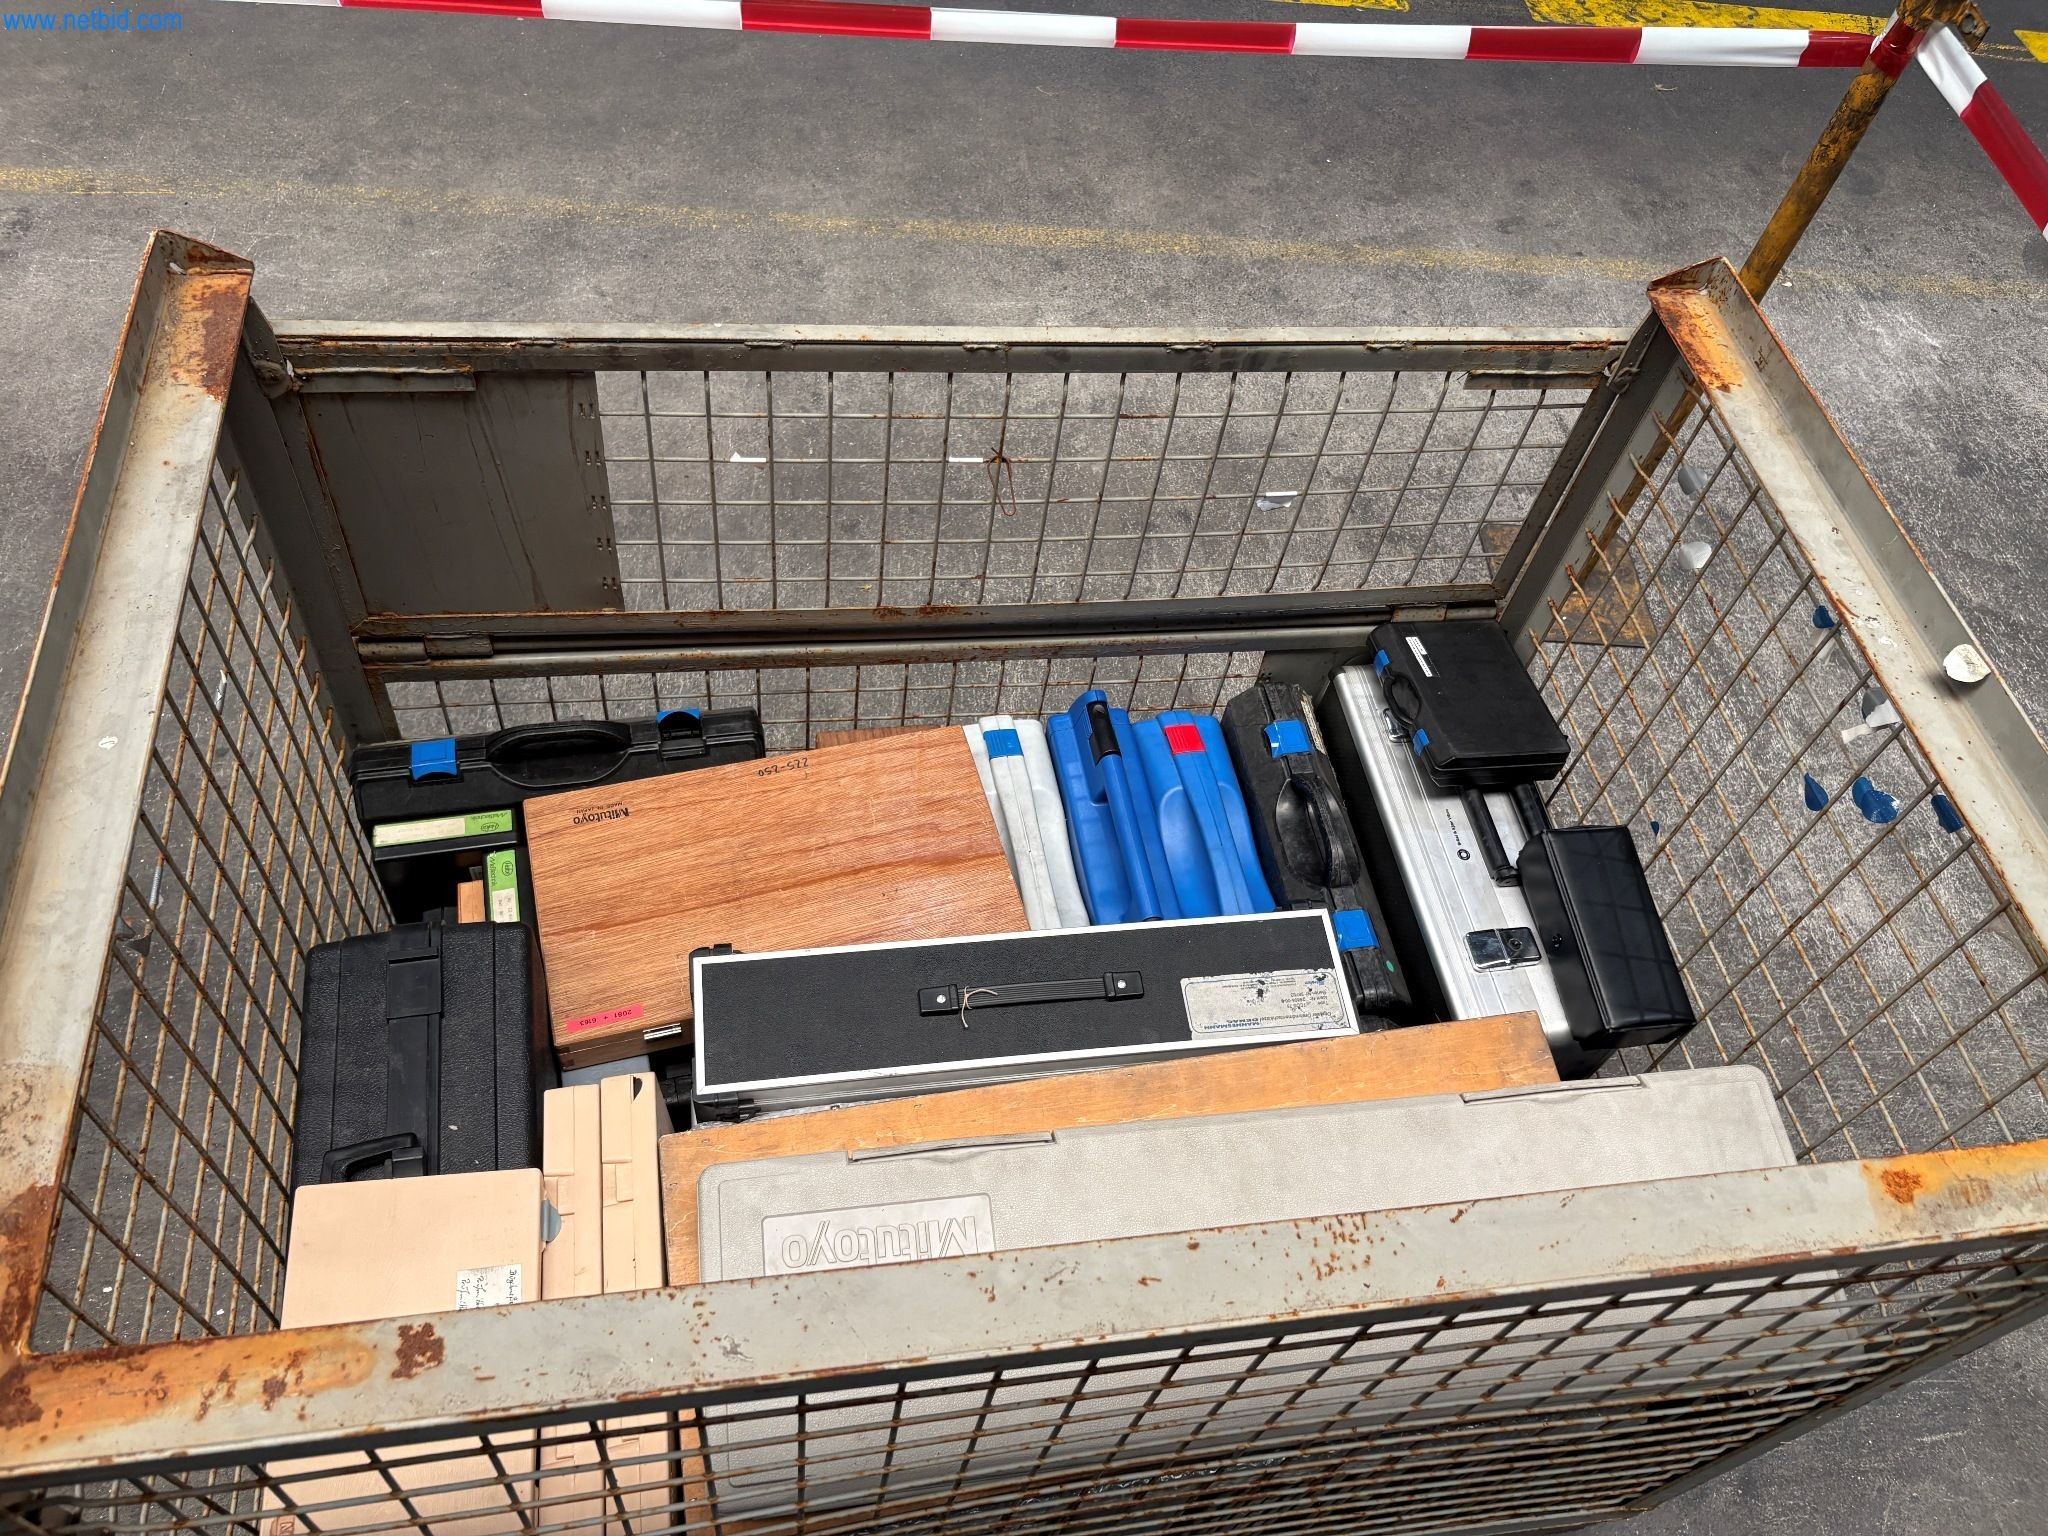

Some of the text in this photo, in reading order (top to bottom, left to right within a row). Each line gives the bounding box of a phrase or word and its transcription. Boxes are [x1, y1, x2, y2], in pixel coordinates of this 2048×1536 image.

[758, 757, 809, 777] 225-250
[573, 807, 630, 825] Mitutoyo
[614, 1009, 632, 1018] 2081
[782, 1216, 979, 1268] Mitutoyo
